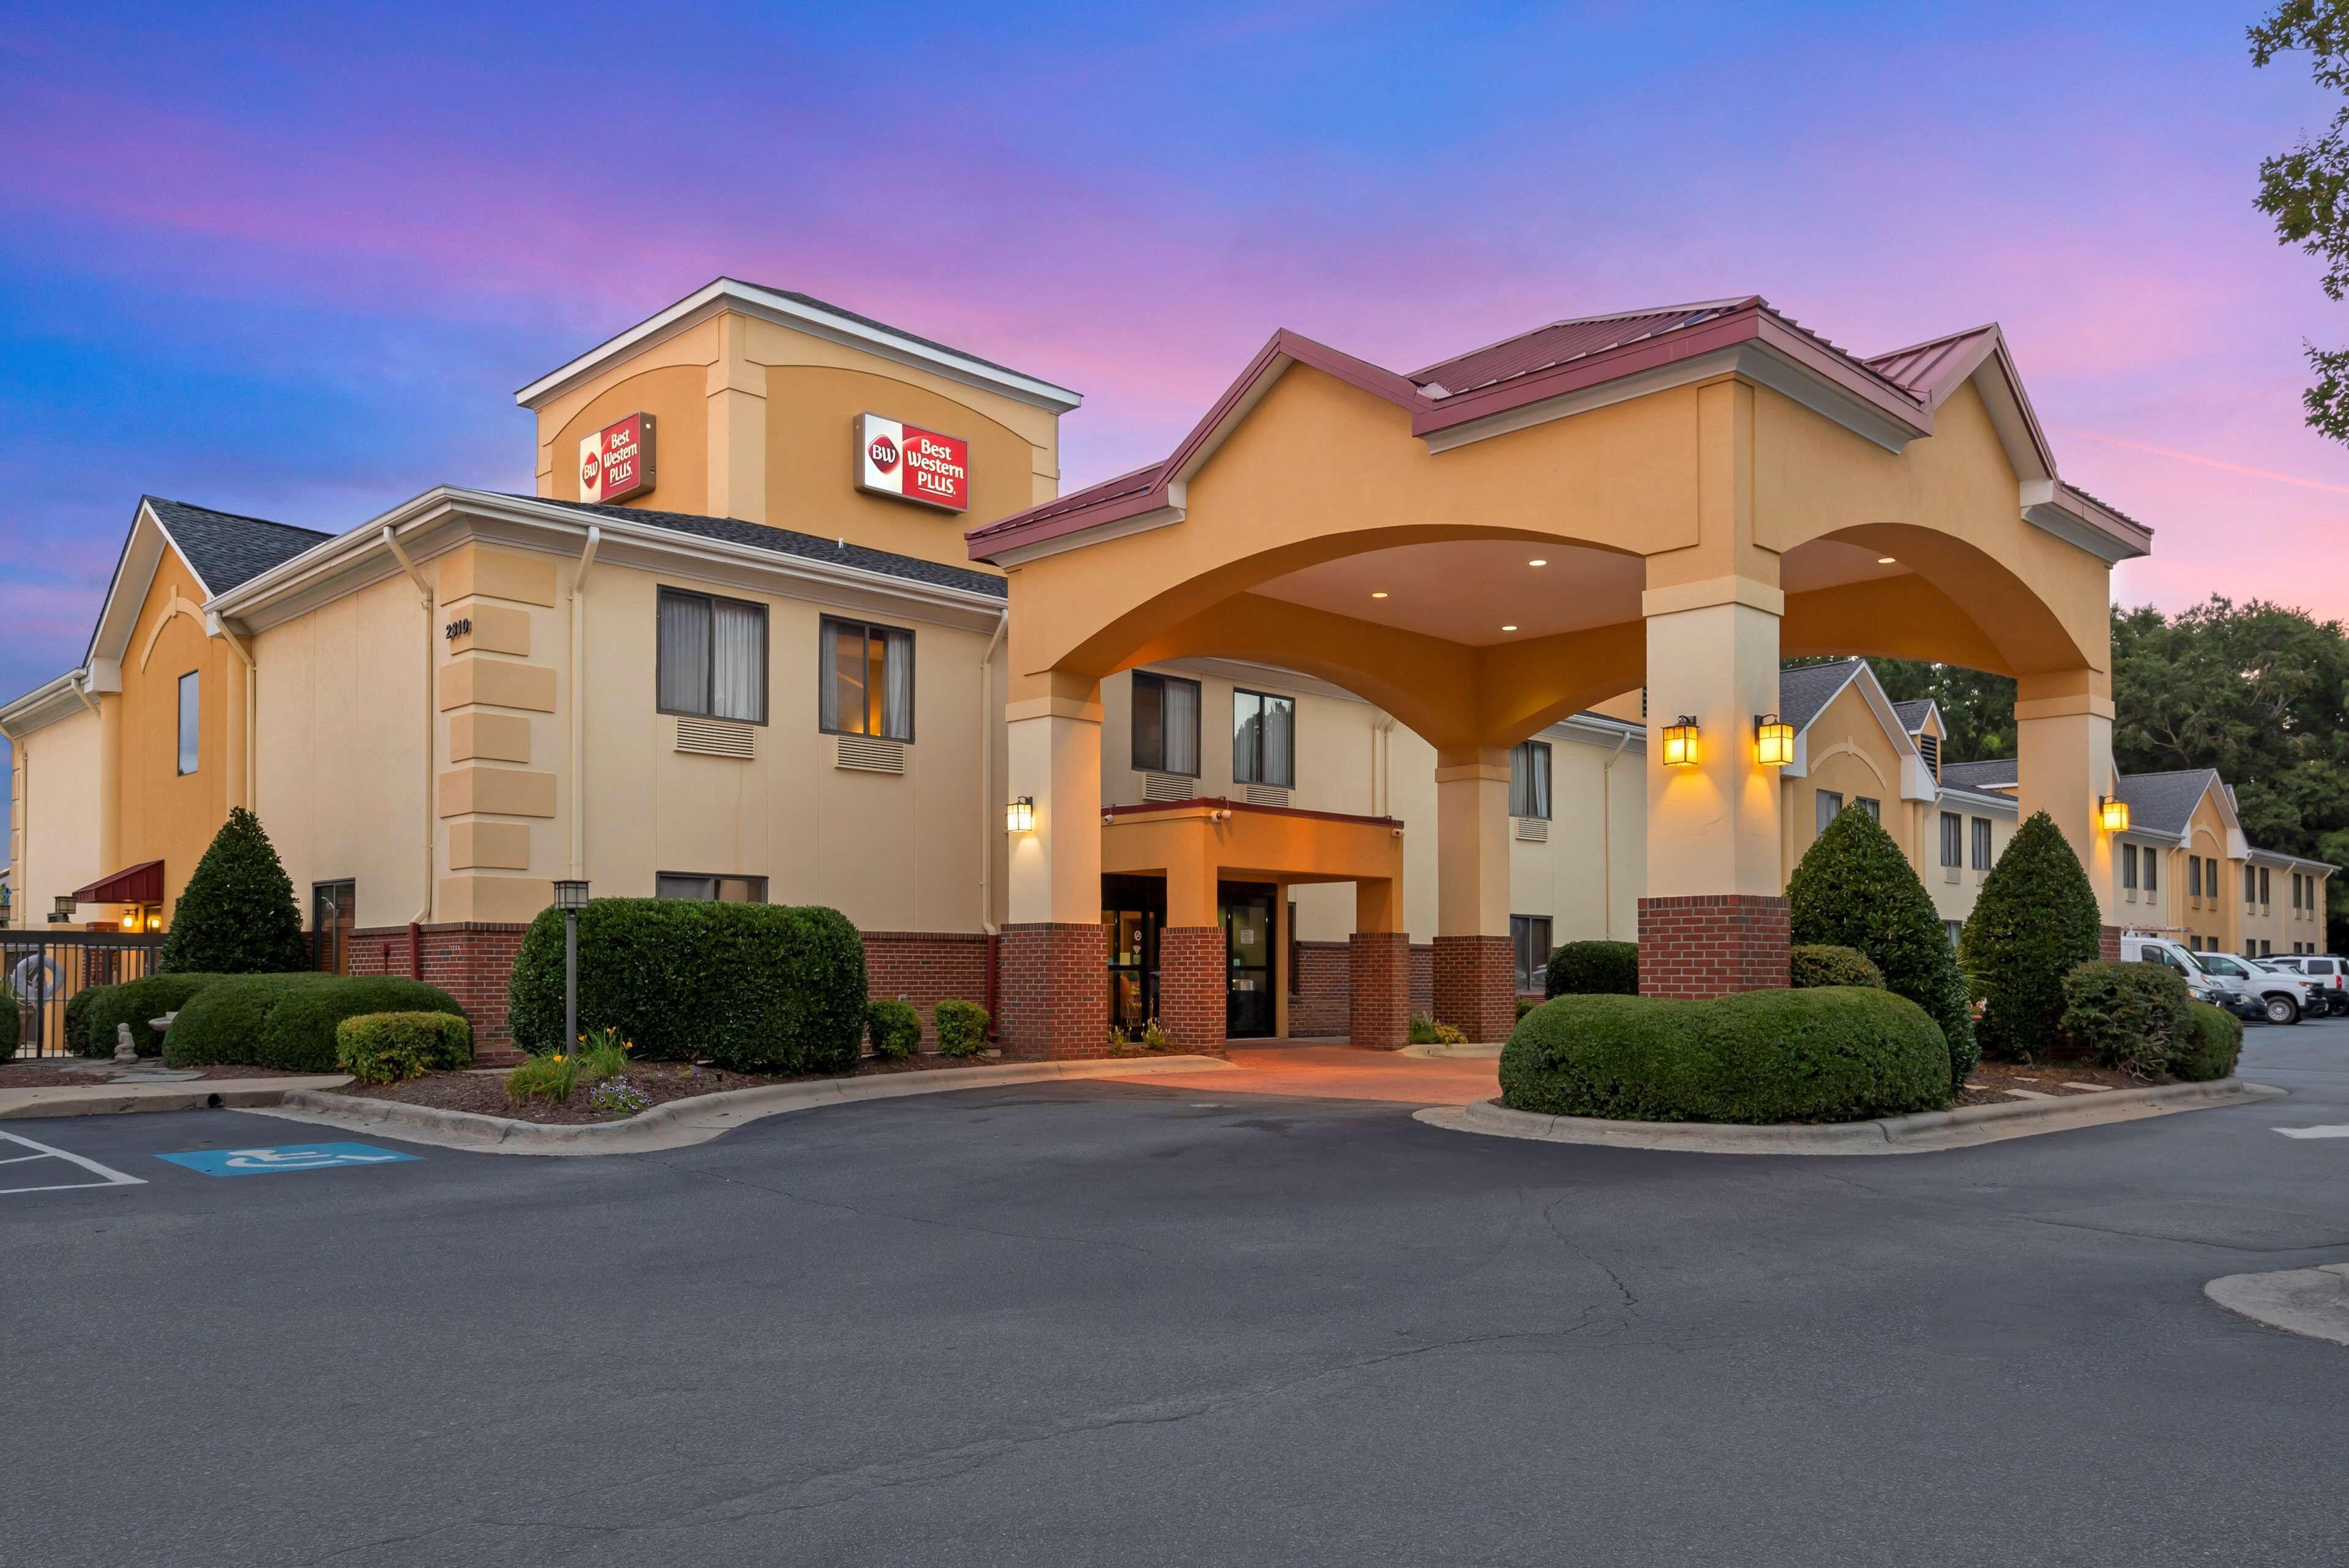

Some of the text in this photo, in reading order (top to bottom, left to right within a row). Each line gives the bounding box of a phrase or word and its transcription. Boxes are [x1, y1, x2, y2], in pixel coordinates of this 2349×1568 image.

[611, 429, 630, 449] Best
[603, 443, 638, 469] Western
[872, 444, 896, 463] BW
[921, 439, 952, 461] Best
[584, 461, 598, 480] BW
[907, 450, 964, 479] Western
[445, 618, 469, 639] 2310
